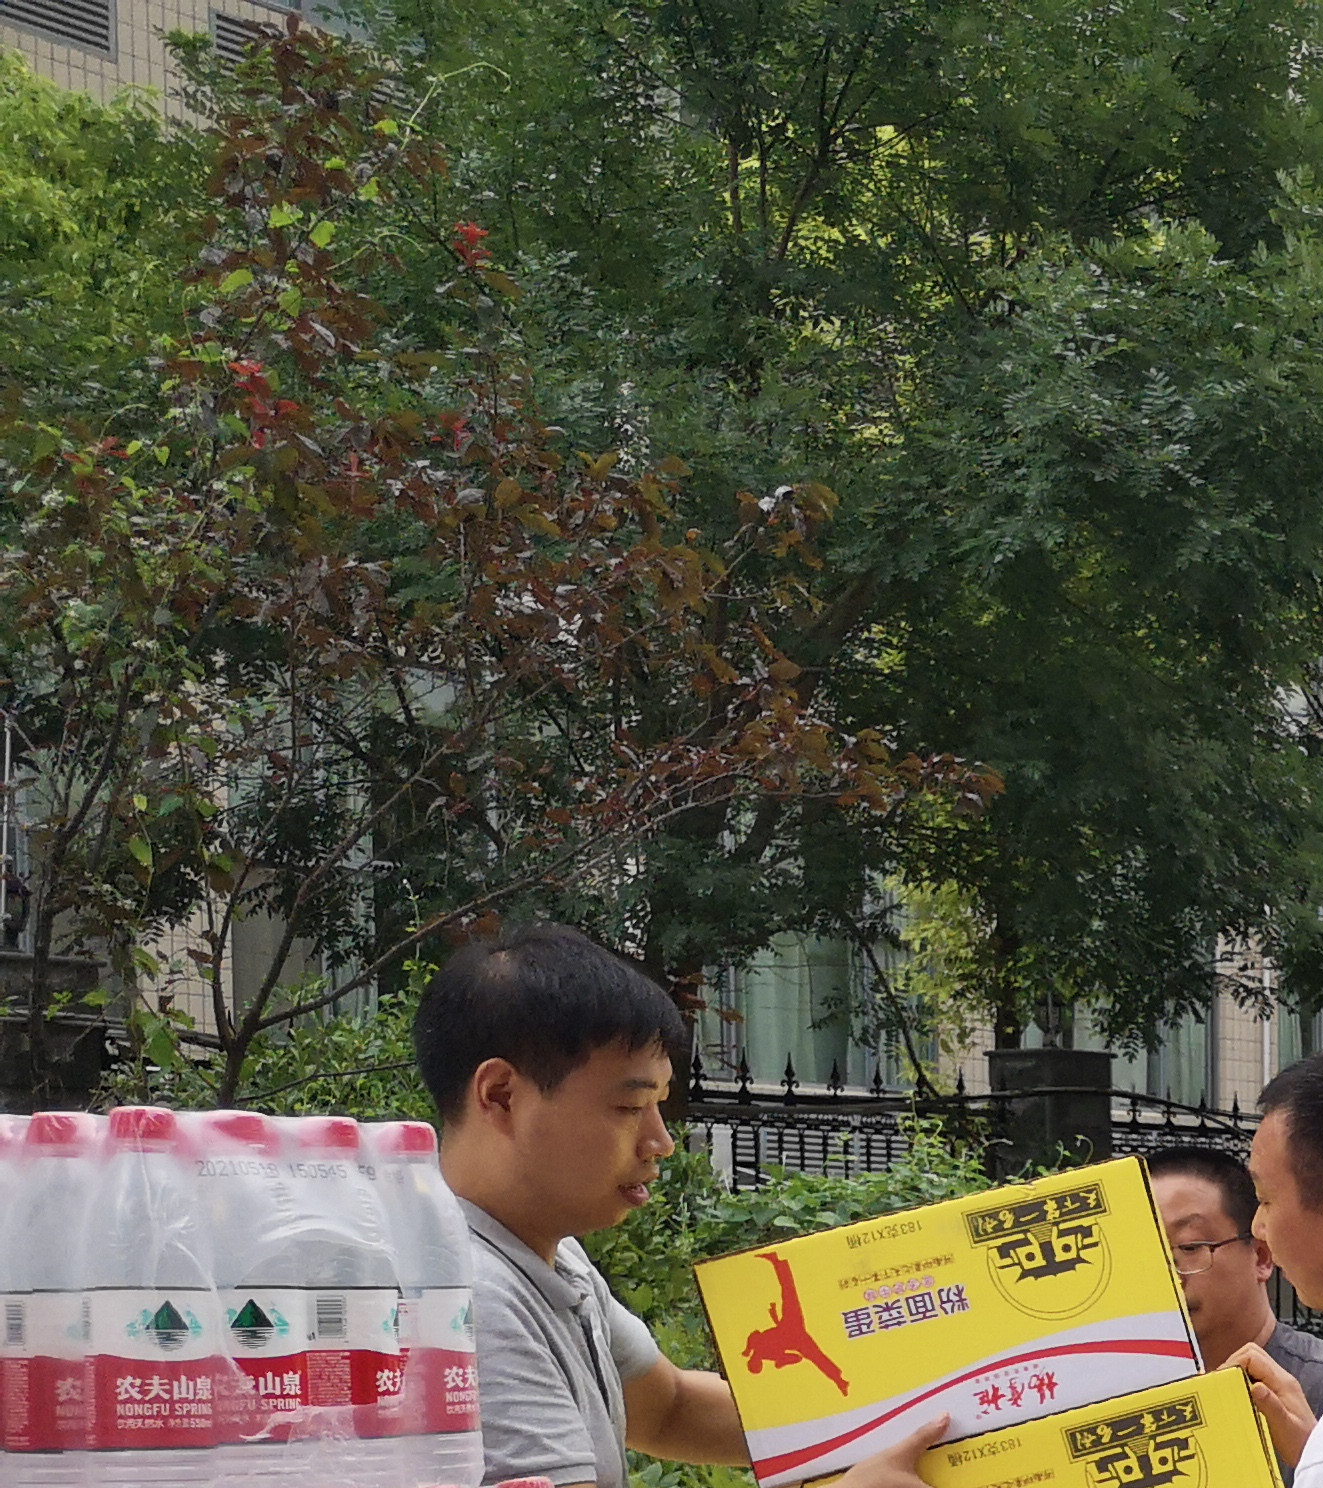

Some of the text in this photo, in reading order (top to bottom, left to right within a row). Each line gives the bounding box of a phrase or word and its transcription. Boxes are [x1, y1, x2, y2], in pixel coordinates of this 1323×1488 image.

[842, 1284, 970, 1338] 粉面菜蛋
[115, 1374, 213, 1401] 农夫山泉
[116, 1403, 170, 1416] NONGFU
